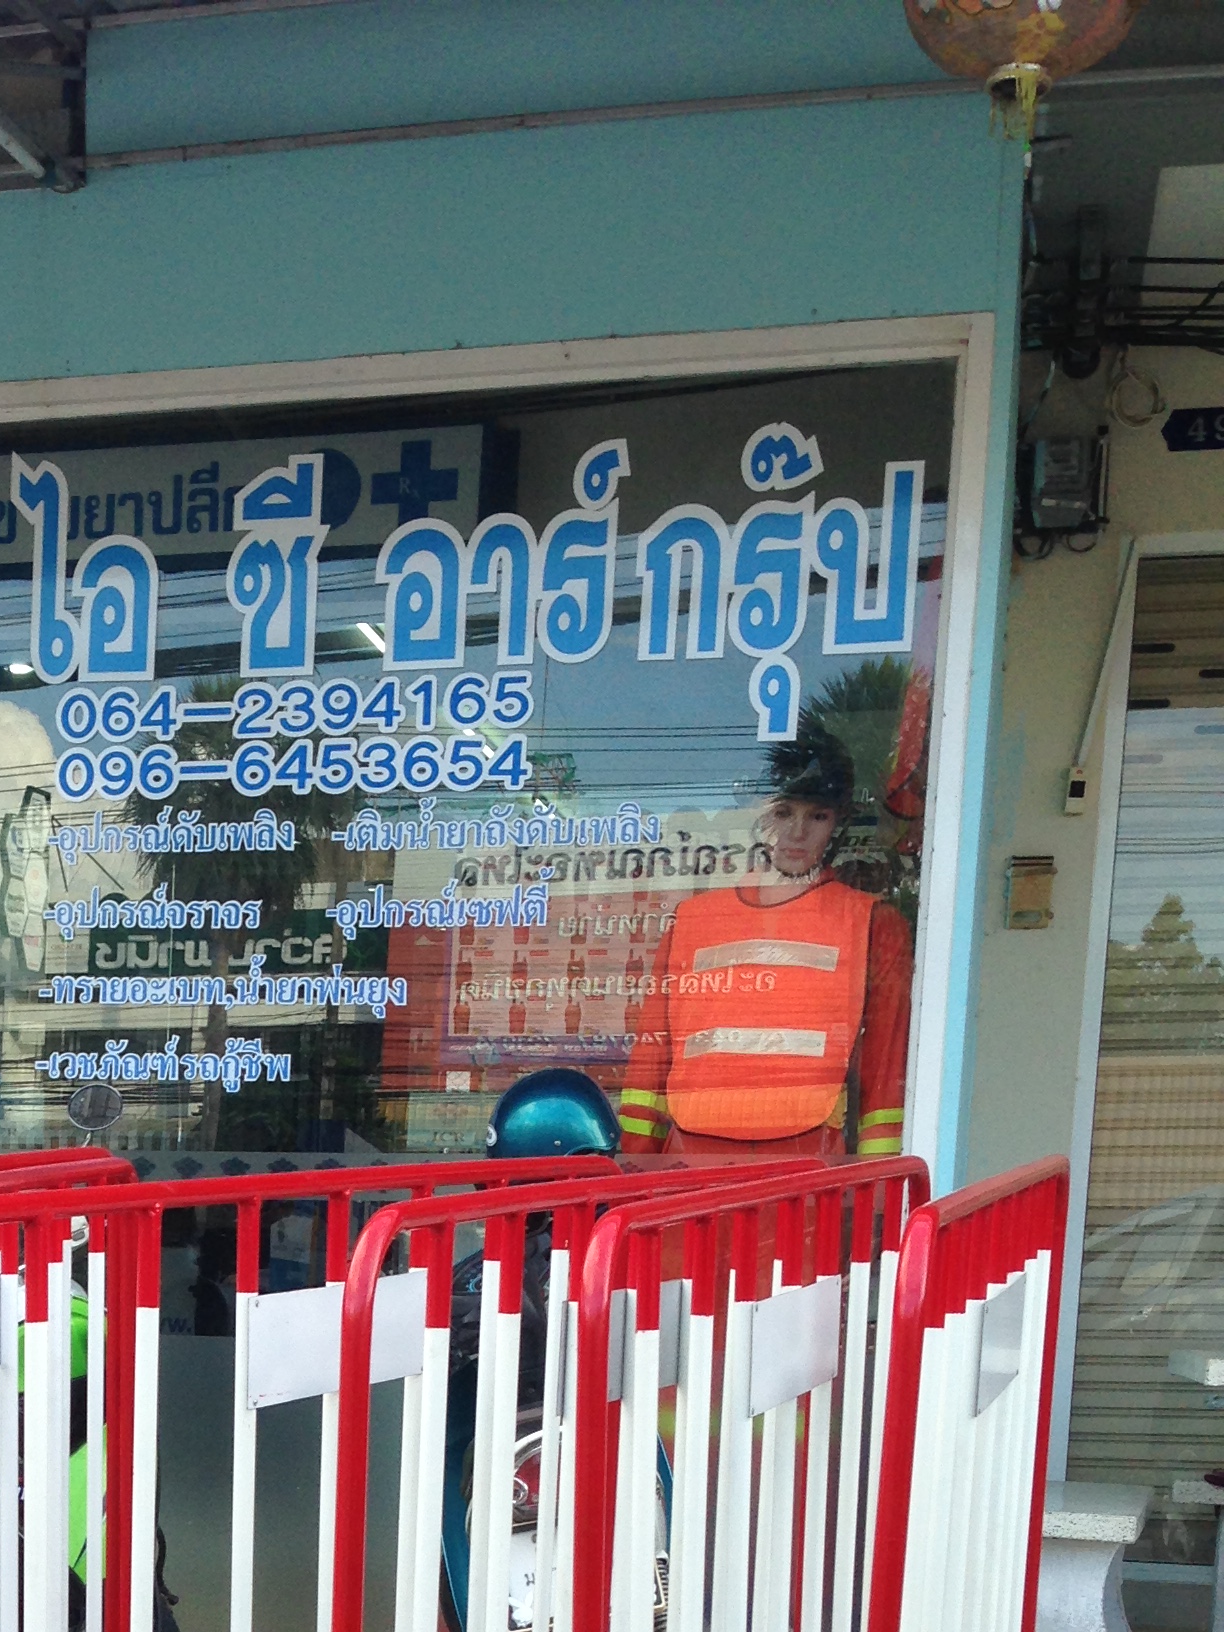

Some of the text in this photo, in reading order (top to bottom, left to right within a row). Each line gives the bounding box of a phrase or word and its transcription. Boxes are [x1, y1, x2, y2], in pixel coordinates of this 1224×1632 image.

[11, 451, 158, 684] ไอ
[227, 454, 329, 678] ซี
[56, 671, 533, 745] 064-2394165
[54, 734, 532, 802] 096-6453654
